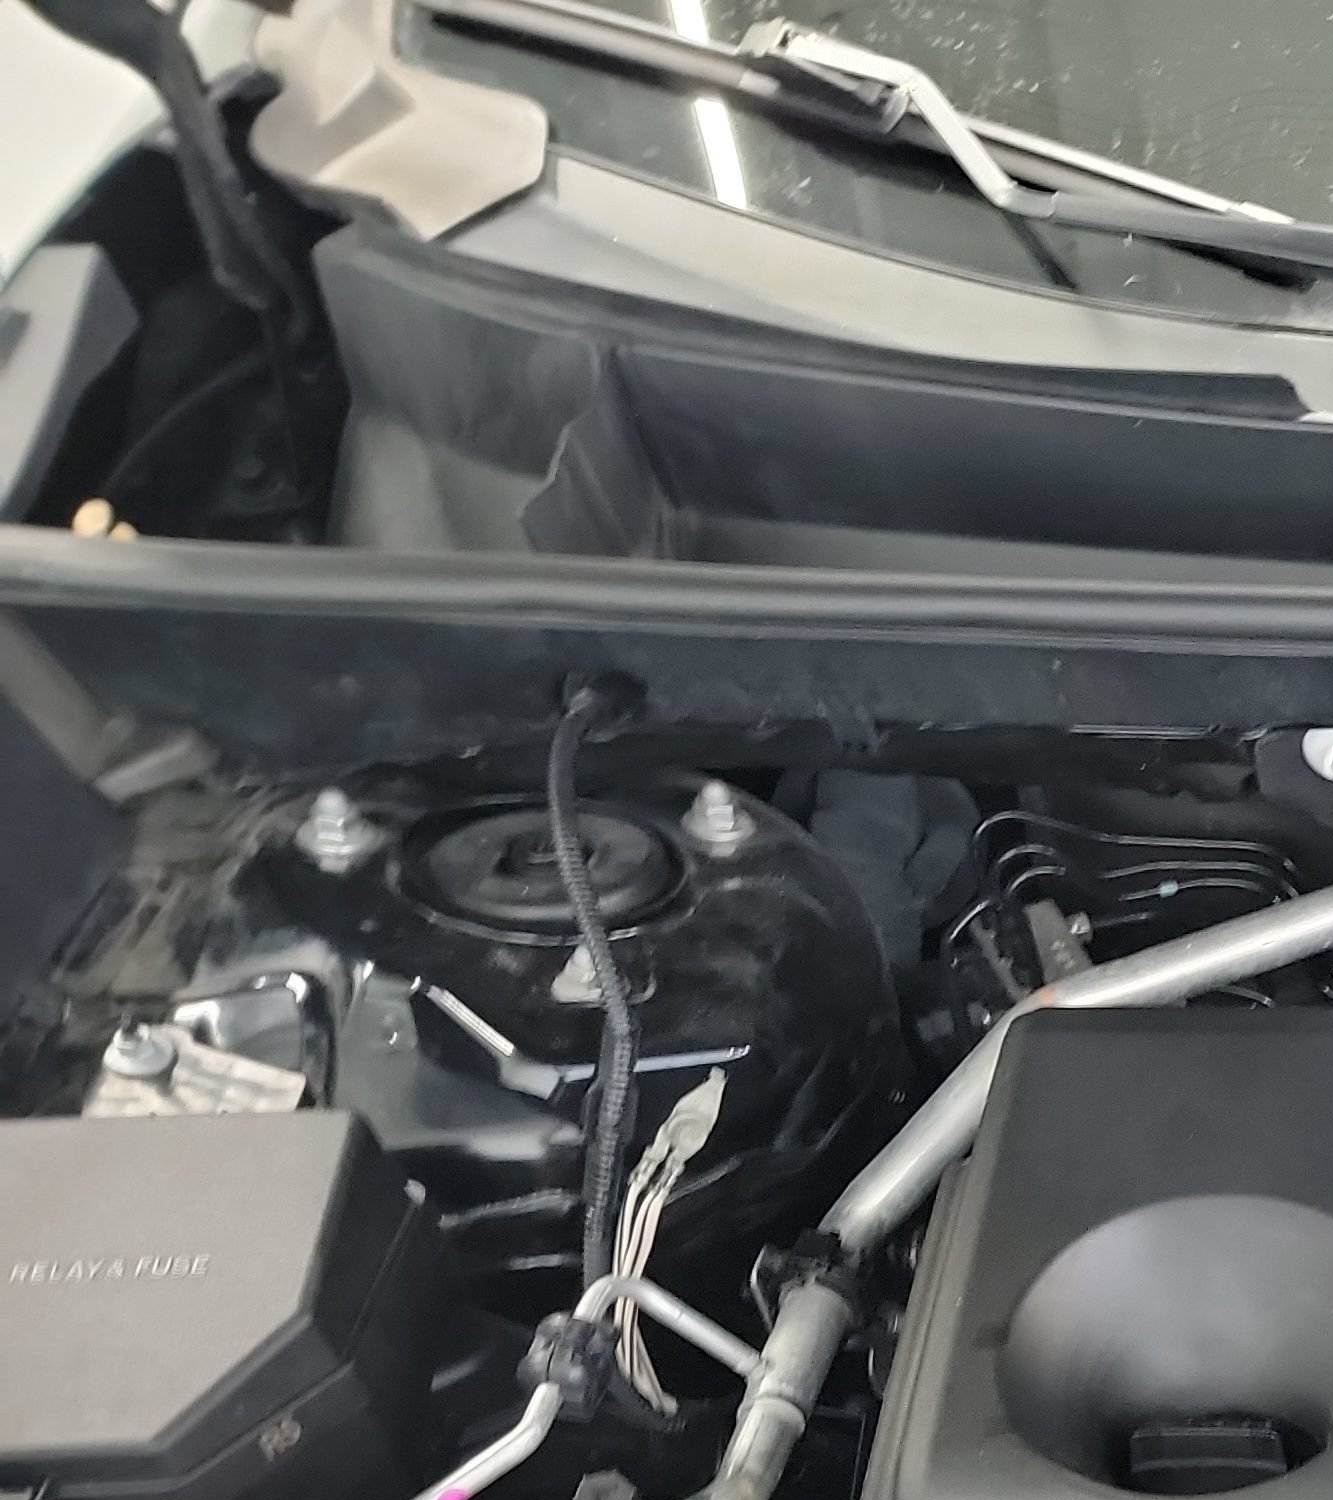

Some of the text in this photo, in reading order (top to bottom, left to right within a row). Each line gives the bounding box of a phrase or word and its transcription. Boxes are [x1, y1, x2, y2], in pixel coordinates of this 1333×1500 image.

[8, 1253, 211, 1286] RELAY & FUSE
